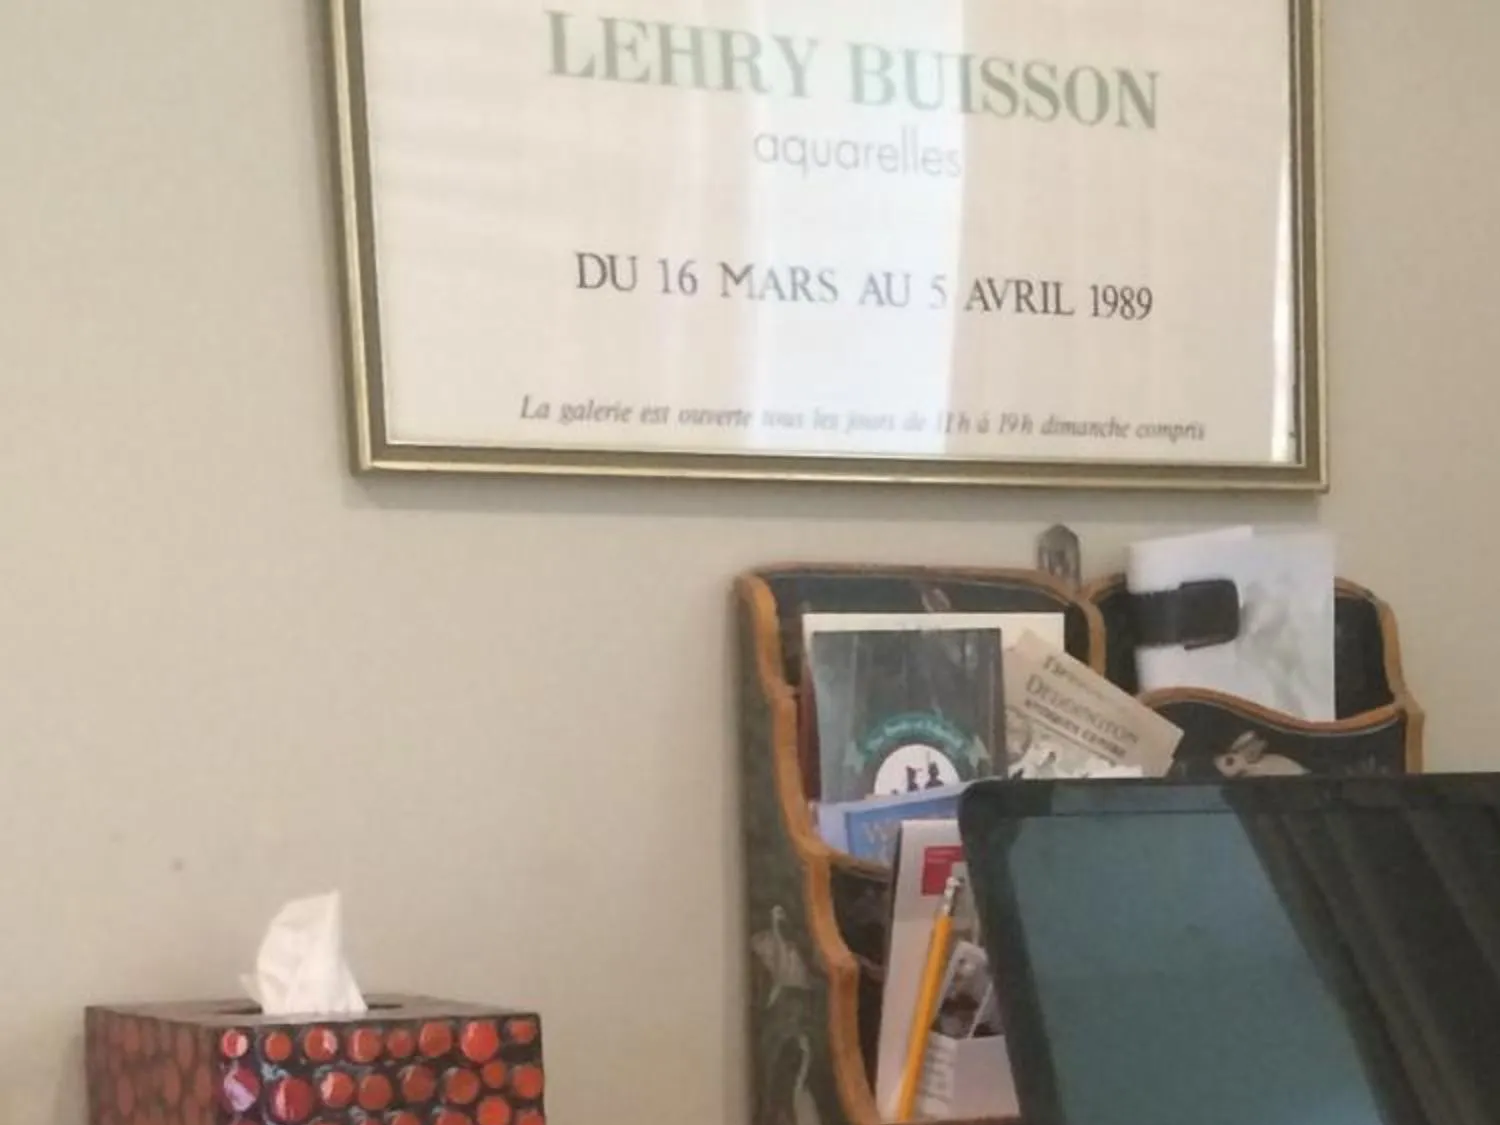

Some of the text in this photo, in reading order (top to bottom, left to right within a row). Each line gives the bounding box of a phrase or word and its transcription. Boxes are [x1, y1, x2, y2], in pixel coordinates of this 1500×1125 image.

[543, 10, 1161, 131] LEHRY BUISSON
[753, 127, 962, 178] aquarelles
[575, 252, 1152, 320] DU 16 MARS AU 5 AVRIL 1989
[520, 394, 550, 420] La
[558, 399, 633, 425] galerie
[639, 404, 670, 424] est
[678, 407, 752, 428] ouverte
[1040, 414, 1132, 439] dimanche
[1135, 420, 1206, 444] compris
